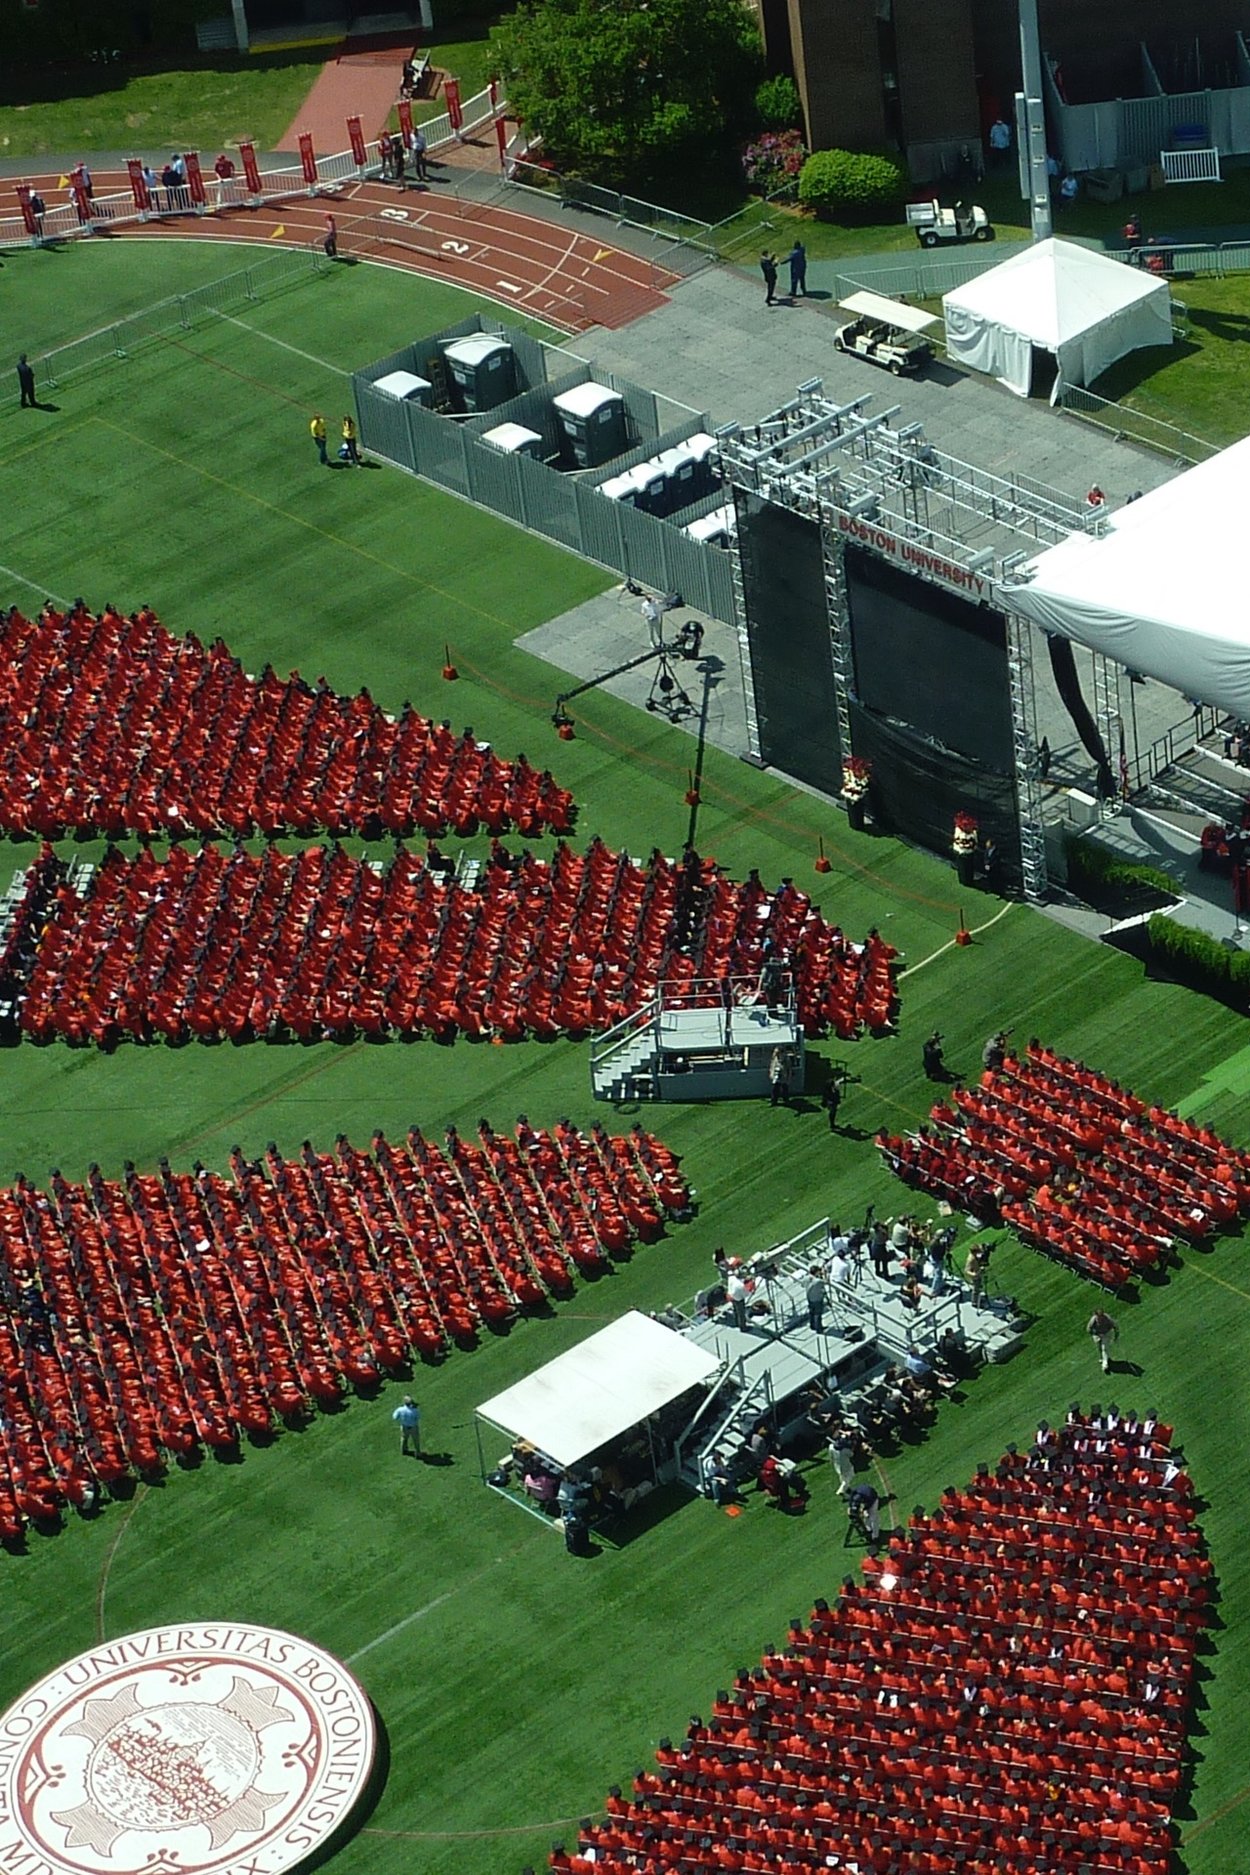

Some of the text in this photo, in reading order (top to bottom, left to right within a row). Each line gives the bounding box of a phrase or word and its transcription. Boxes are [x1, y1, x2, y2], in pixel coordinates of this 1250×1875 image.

[380, 208, 409, 220] 3
[441, 241, 469, 254] 2
[496, 280, 522, 293] 1
[839, 515, 984, 595] BOSTON UNIVERSITY
[63, 1629, 361, 1849] UNIVERSITAS BOSTONIENSIS
